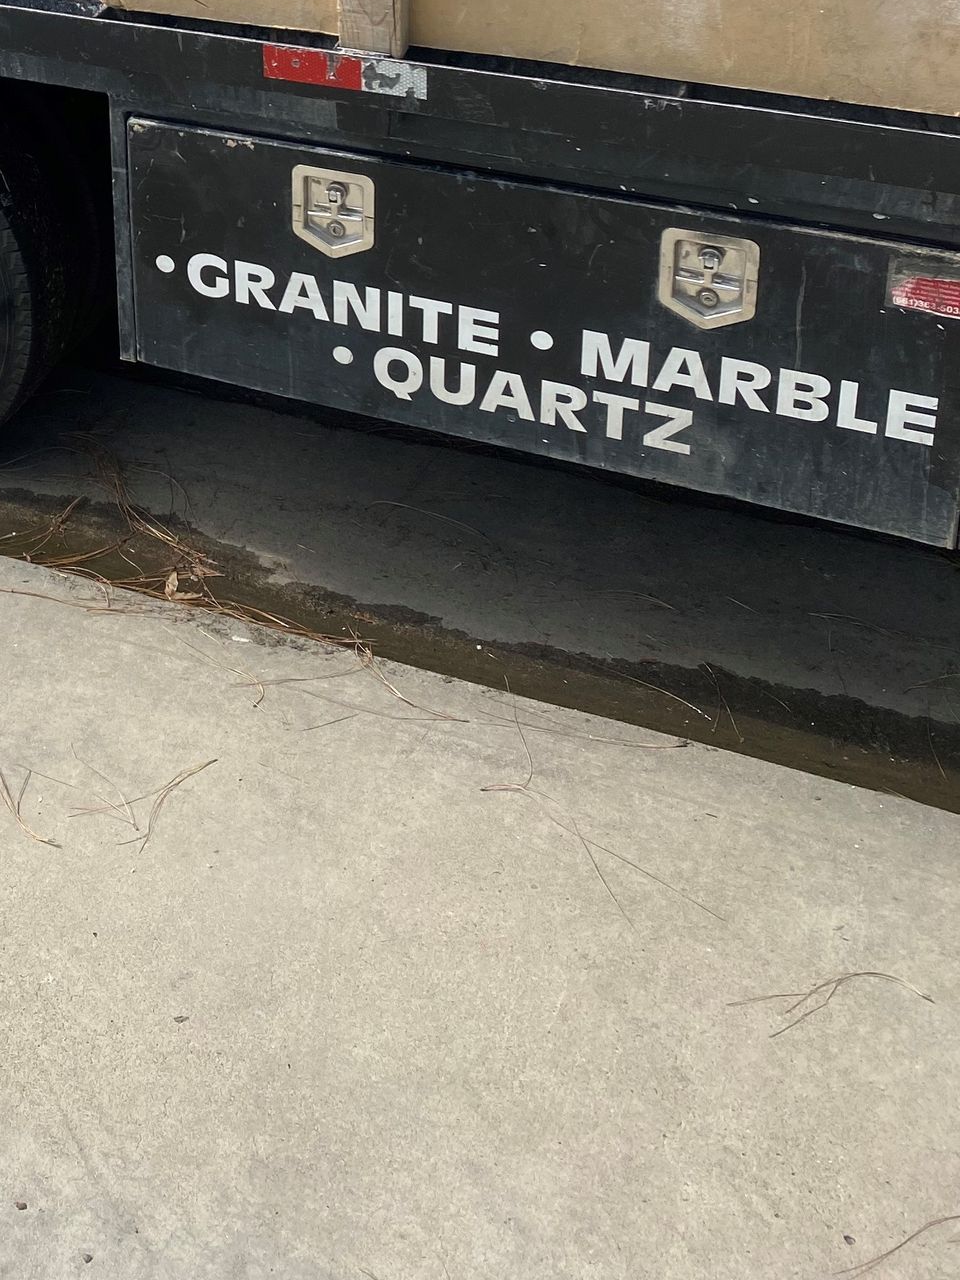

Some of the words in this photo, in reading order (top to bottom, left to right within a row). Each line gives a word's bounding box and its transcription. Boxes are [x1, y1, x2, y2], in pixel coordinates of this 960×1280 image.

[187, 253, 500, 357] GRANITE
[580, 329, 939, 446] MARBLE
[373, 347, 694, 456] QUARTZ
